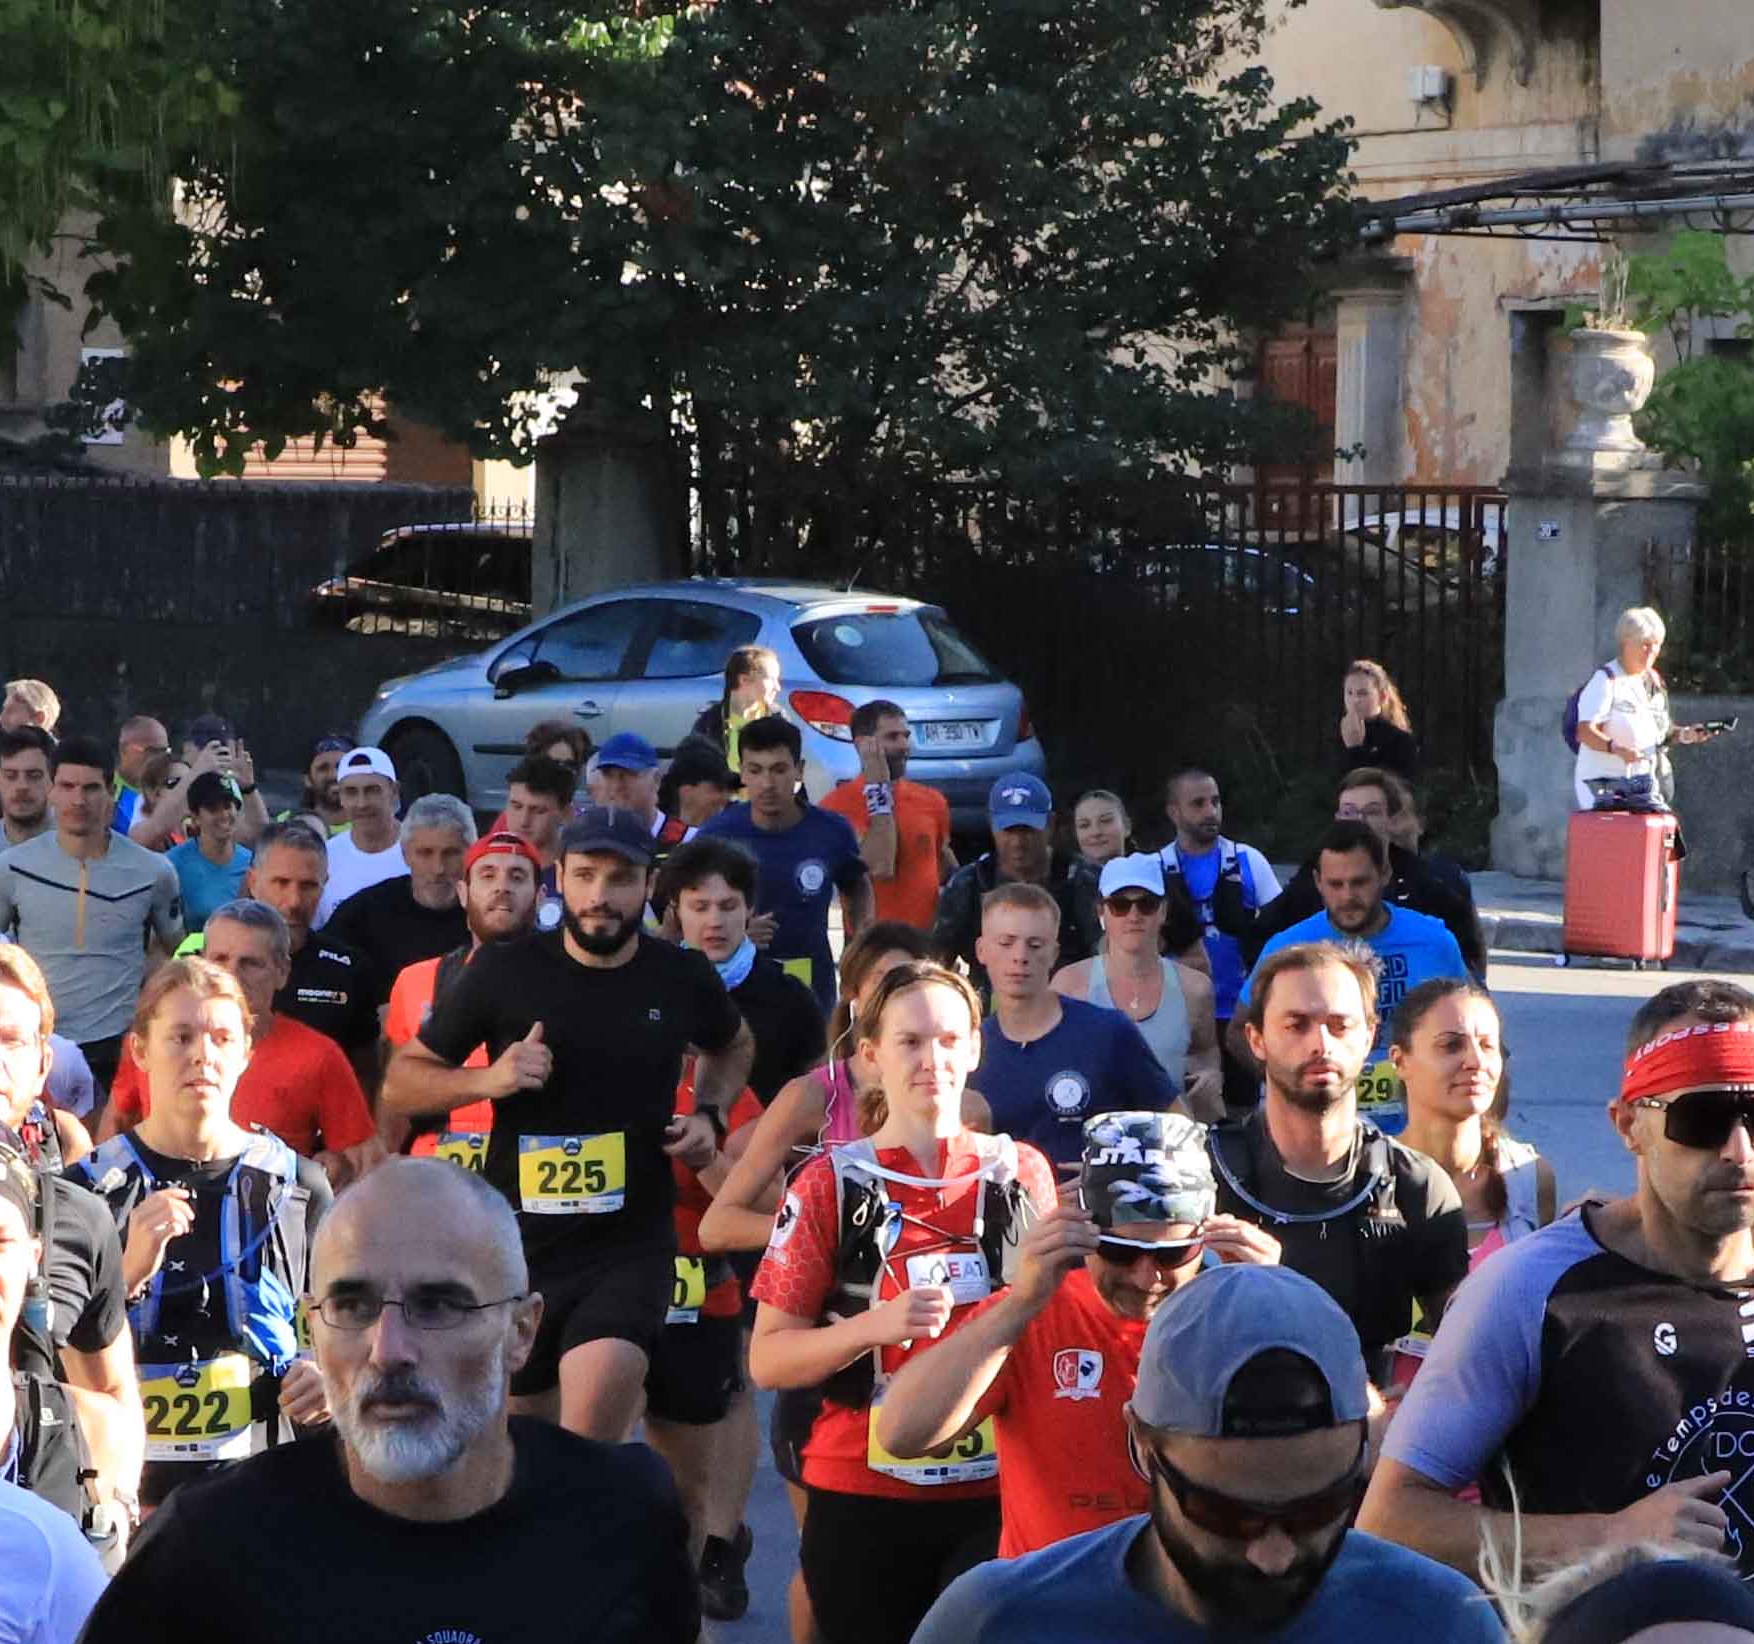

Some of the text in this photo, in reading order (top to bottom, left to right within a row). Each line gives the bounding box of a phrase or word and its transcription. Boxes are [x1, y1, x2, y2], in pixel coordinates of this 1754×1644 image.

[1358, 1078, 1392, 1102] 29
[538, 1160, 606, 1194] 225
[145, 1390, 231, 1436] 222
[1652, 1396, 1718, 1462] Temps
